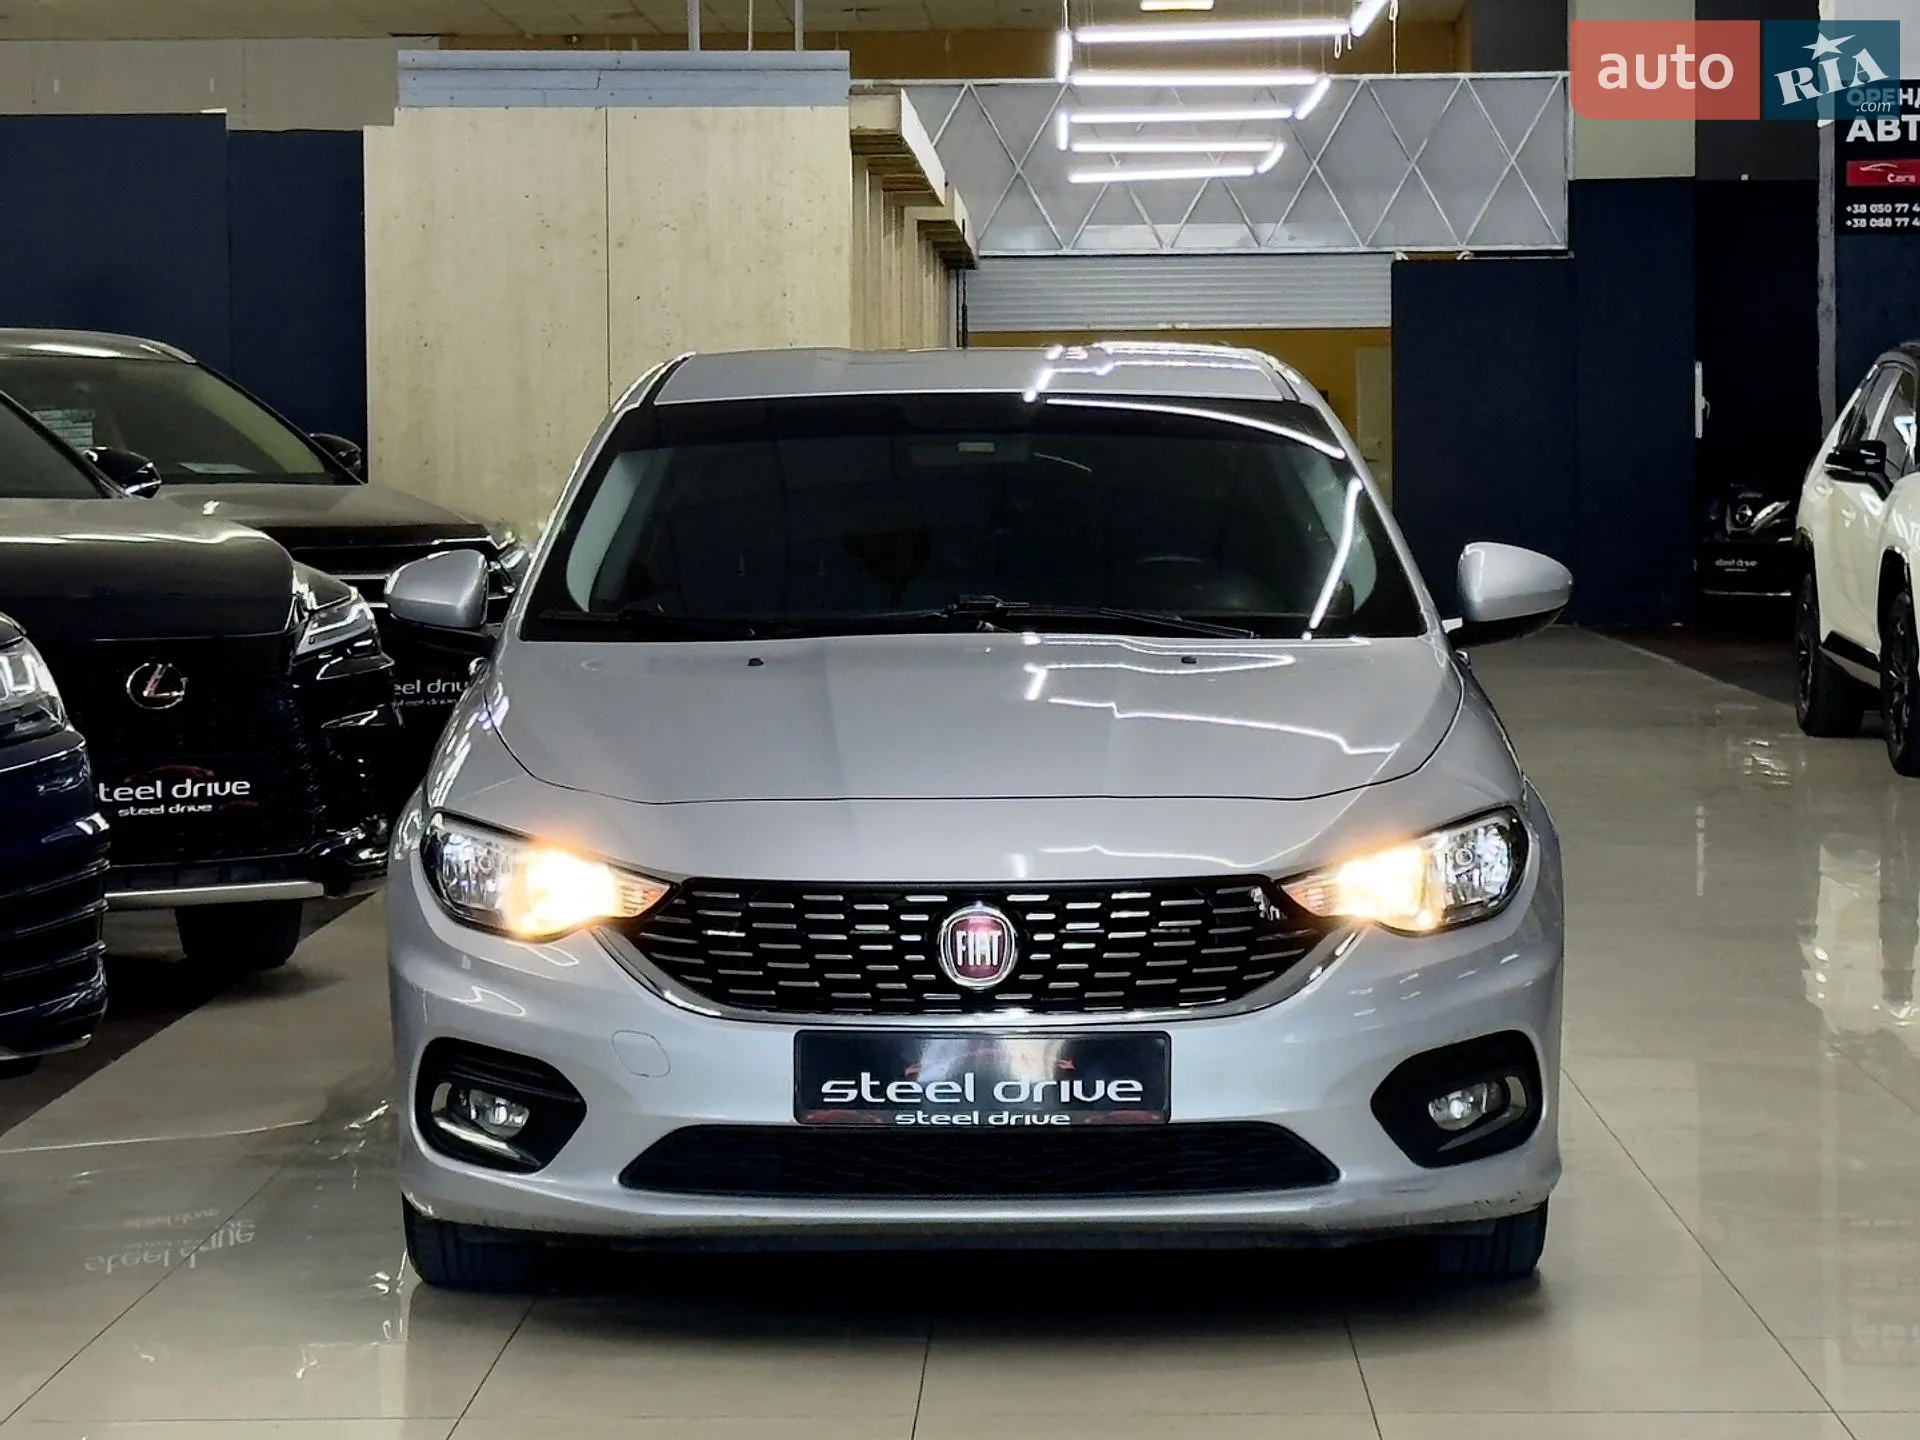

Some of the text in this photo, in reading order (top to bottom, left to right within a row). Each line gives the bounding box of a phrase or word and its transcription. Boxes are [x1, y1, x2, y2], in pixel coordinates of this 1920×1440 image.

[1895, 203, 1909, 213] 77
[1895, 217, 1910, 227] 77
[98, 778, 250, 802] teel drive
[118, 803, 213, 817] steel drive
[956, 930, 1001, 966] FIAT
[821, 1072, 1143, 1103] steel drive
[895, 1110, 1070, 1126] steel drive
